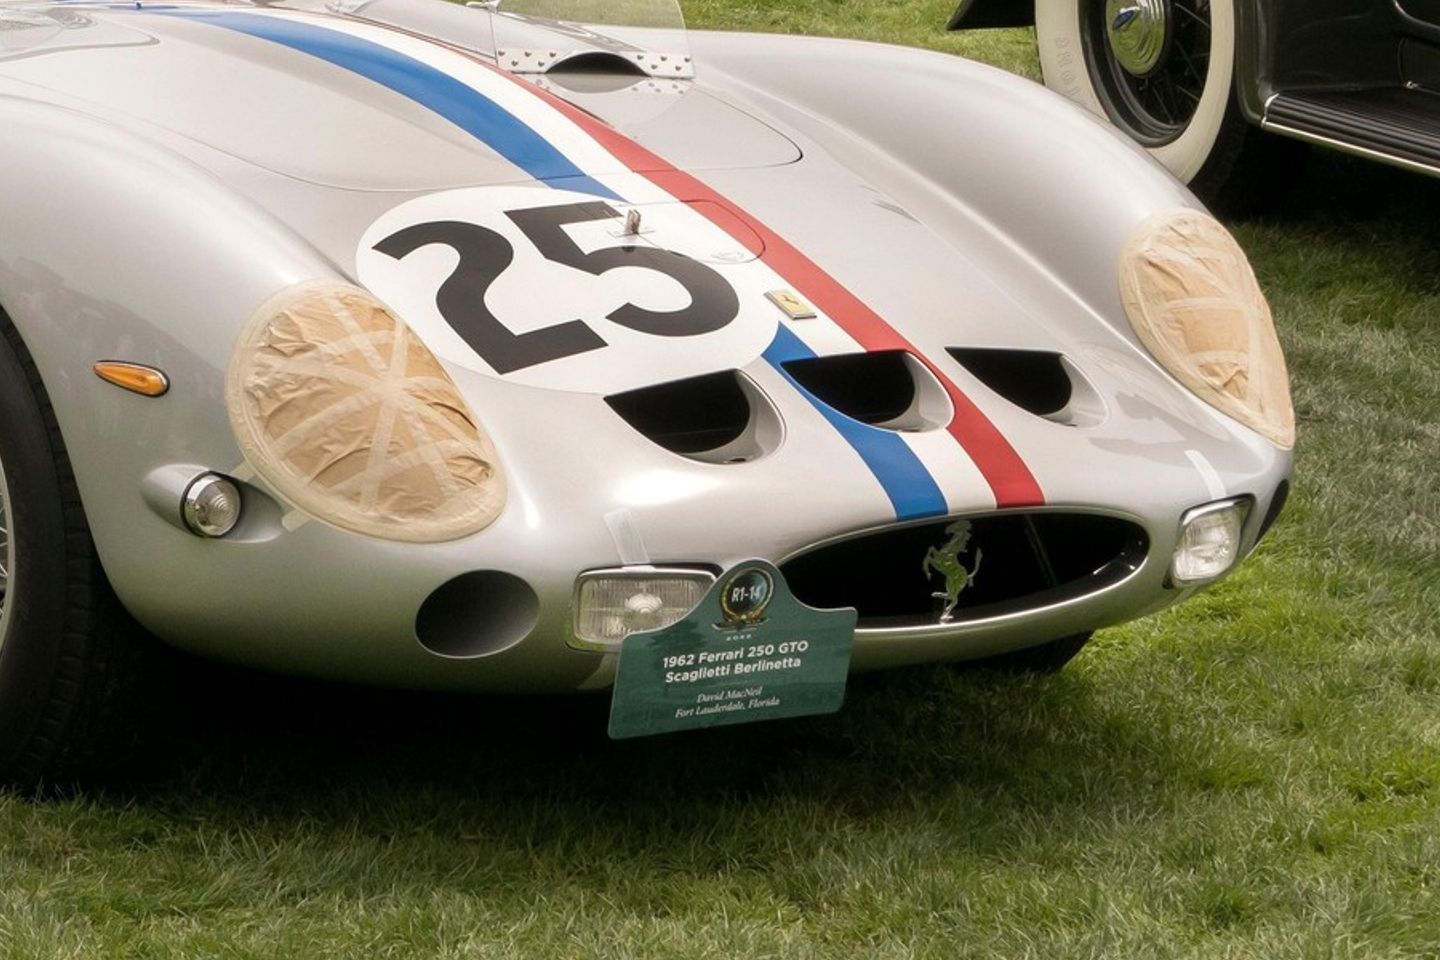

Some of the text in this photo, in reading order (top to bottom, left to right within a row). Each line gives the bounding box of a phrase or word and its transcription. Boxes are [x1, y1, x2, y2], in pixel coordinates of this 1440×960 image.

[372, 200, 740, 375] 25
[662, 640, 809, 669] 1962 Ferrari 250 GTO
[665, 657, 802, 683] Scaglietti Berlinetta
[675, 708, 694, 720] Fort
[748, 696, 780, 709] Florida
[696, 686, 763, 704] David MacNeil
